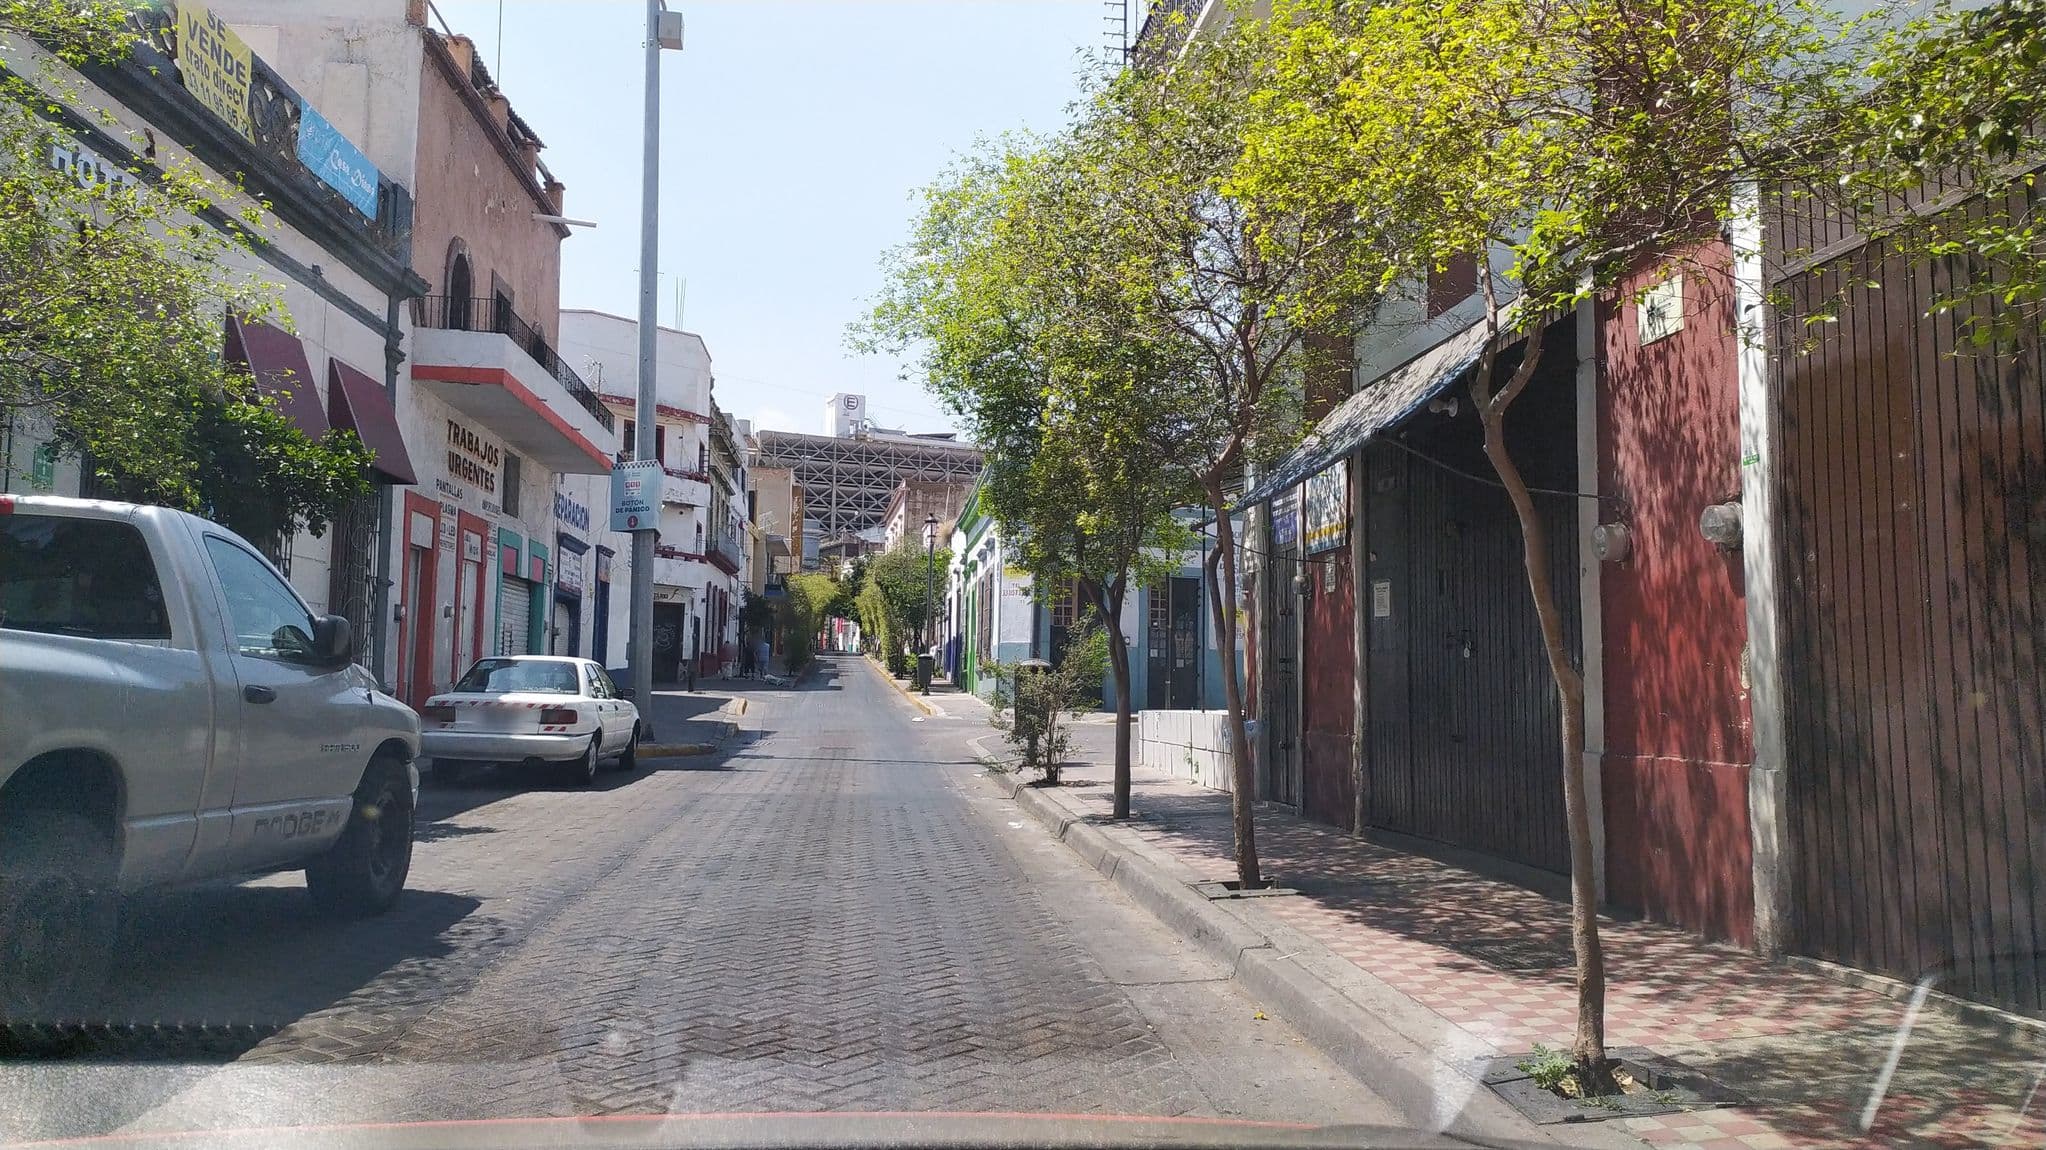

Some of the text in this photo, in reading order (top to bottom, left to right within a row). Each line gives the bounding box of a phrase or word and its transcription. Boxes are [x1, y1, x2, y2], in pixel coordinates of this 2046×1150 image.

[207, 8, 226, 42] SE
[185, 40, 210, 81] trato
[187, 11, 247, 88] VENDE
[447, 419, 499, 468] TRABAJOS
[436, 478, 463, 500] PANTALLAS
[448, 450, 495, 493] URGENTES
